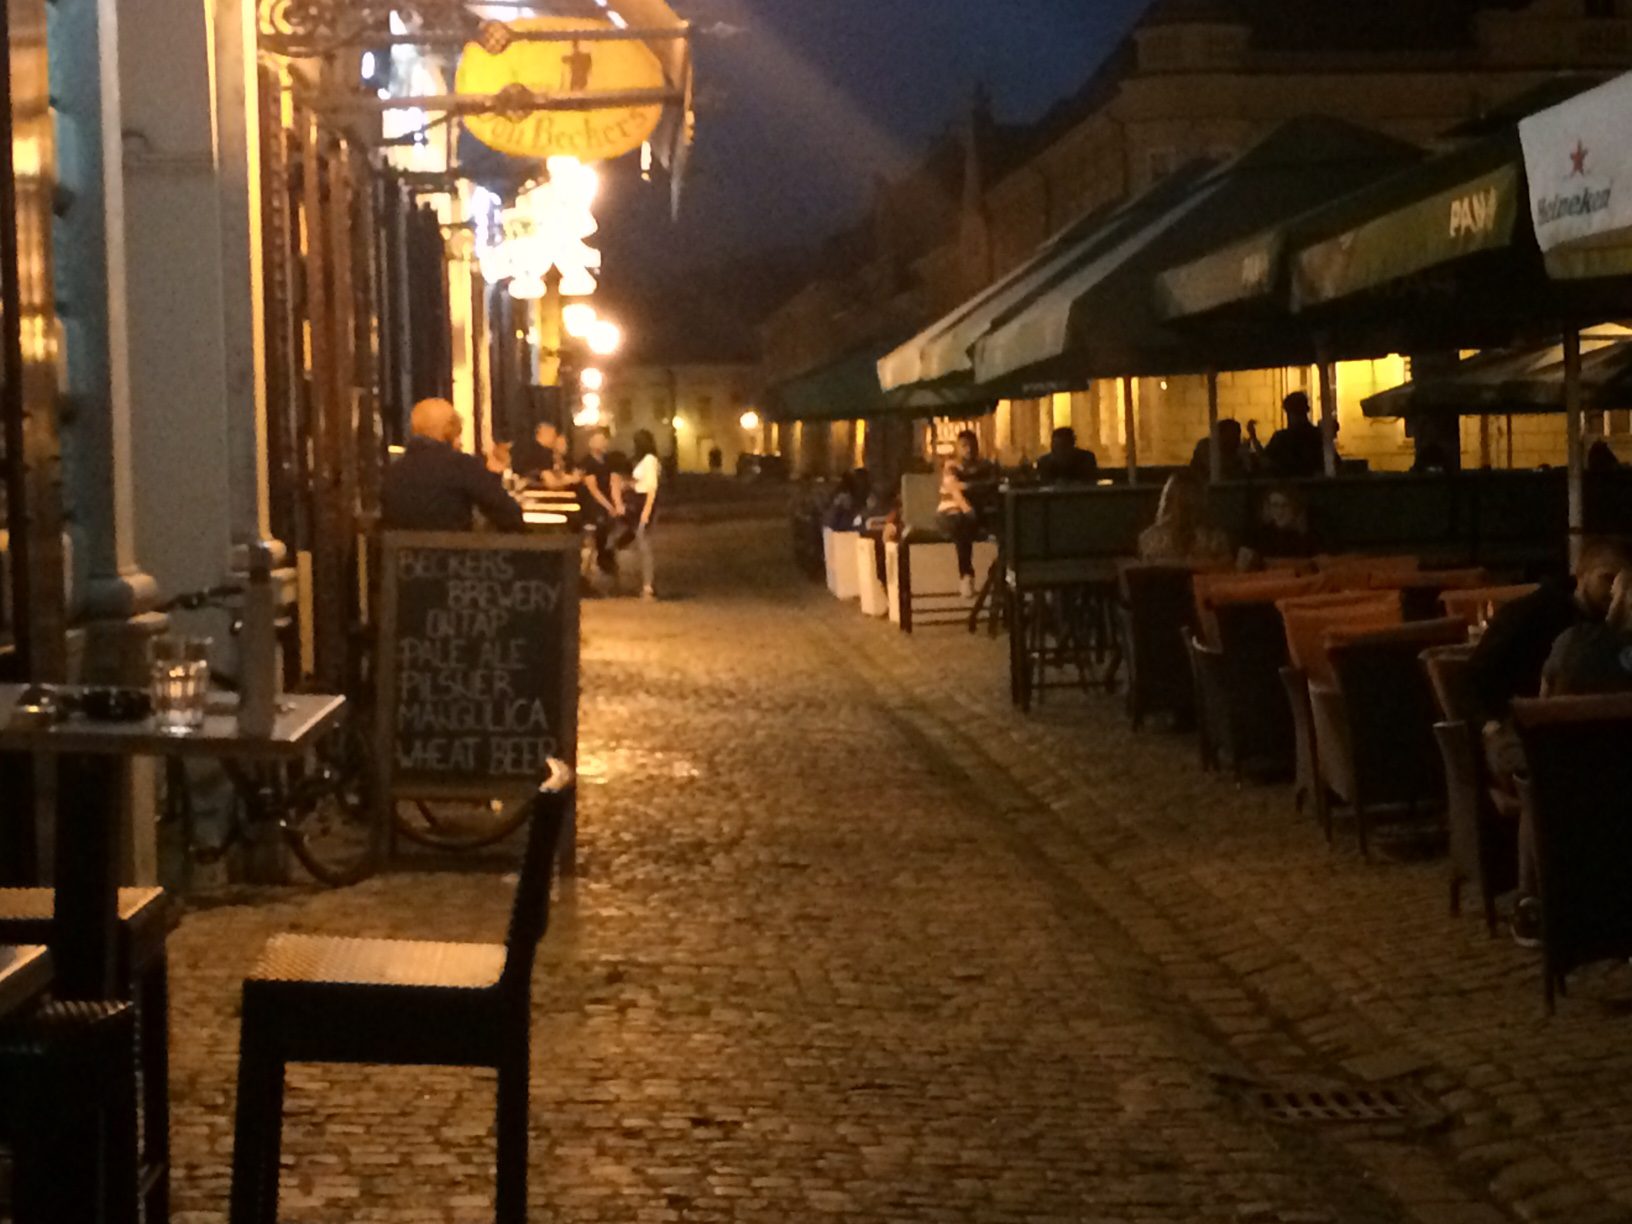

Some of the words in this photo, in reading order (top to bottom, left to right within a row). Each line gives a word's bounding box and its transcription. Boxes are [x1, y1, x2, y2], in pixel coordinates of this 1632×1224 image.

[399, 636, 468, 669] PALE
[479, 637, 527, 670] ALE
[395, 736, 481, 770] WHEAT
